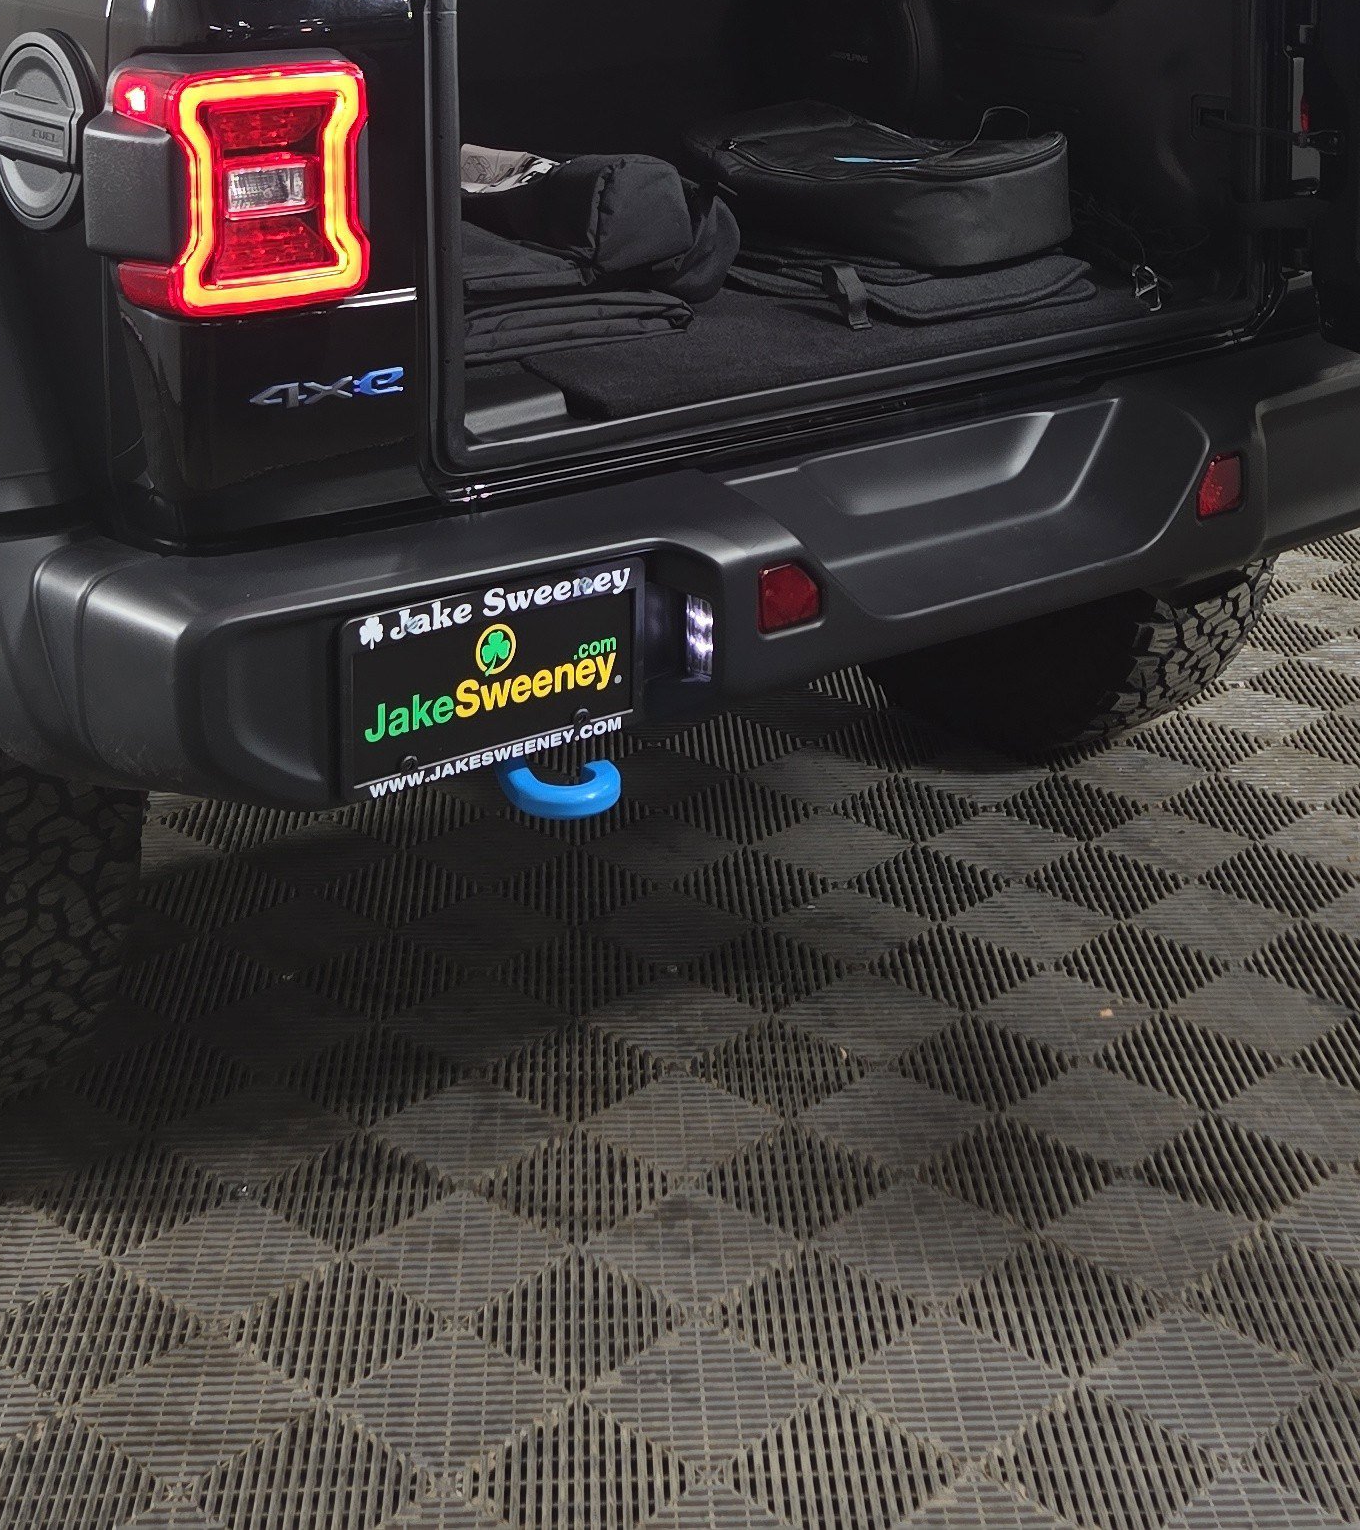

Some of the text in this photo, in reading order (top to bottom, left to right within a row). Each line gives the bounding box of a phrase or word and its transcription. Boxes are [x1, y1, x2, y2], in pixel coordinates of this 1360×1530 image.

[390, 567, 630, 640] Jake Sweeney
[573, 636, 617, 660] .com
[369, 716, 622, 799] WWW.JAKESWEENEY.COM
